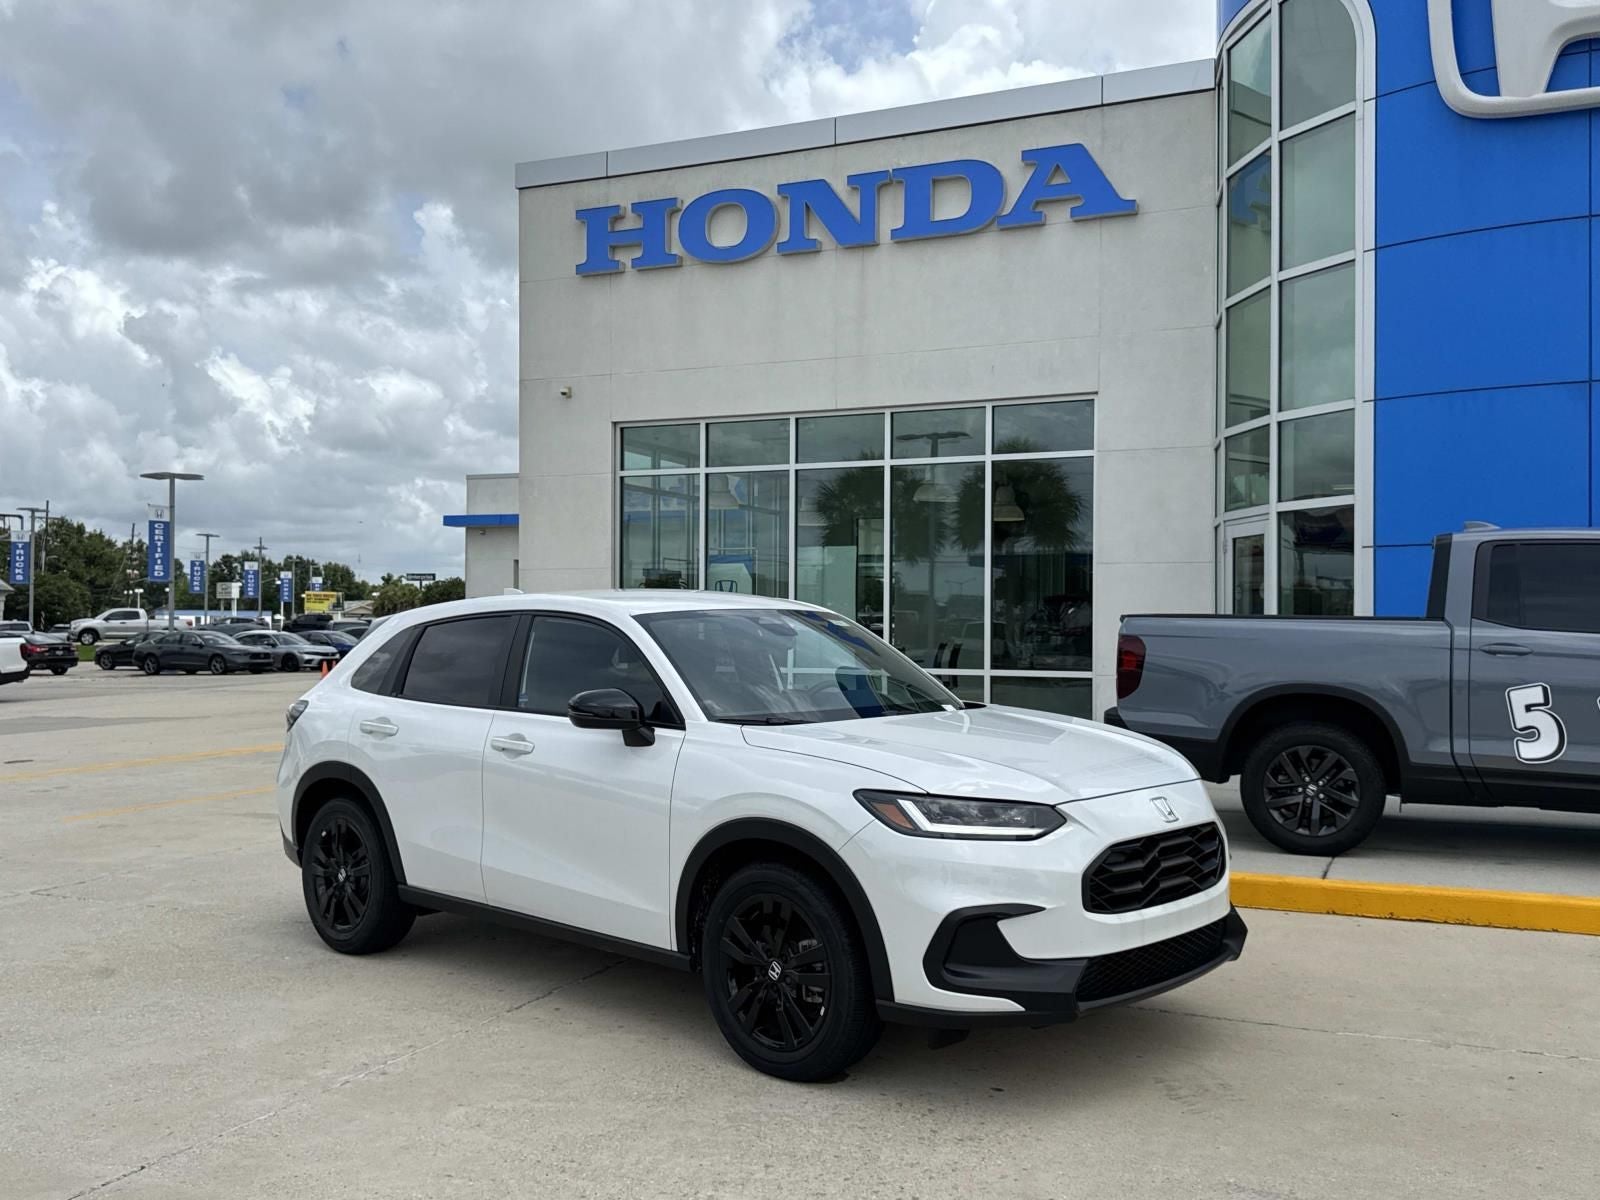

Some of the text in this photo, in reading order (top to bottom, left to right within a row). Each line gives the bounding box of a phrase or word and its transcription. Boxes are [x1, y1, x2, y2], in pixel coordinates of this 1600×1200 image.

[575, 142, 1138, 276] HONDA
[15, 542, 25, 581] TRUCKS
[153, 522, 165, 577] CERTIFIED
[1505, 682, 1567, 764] 5
